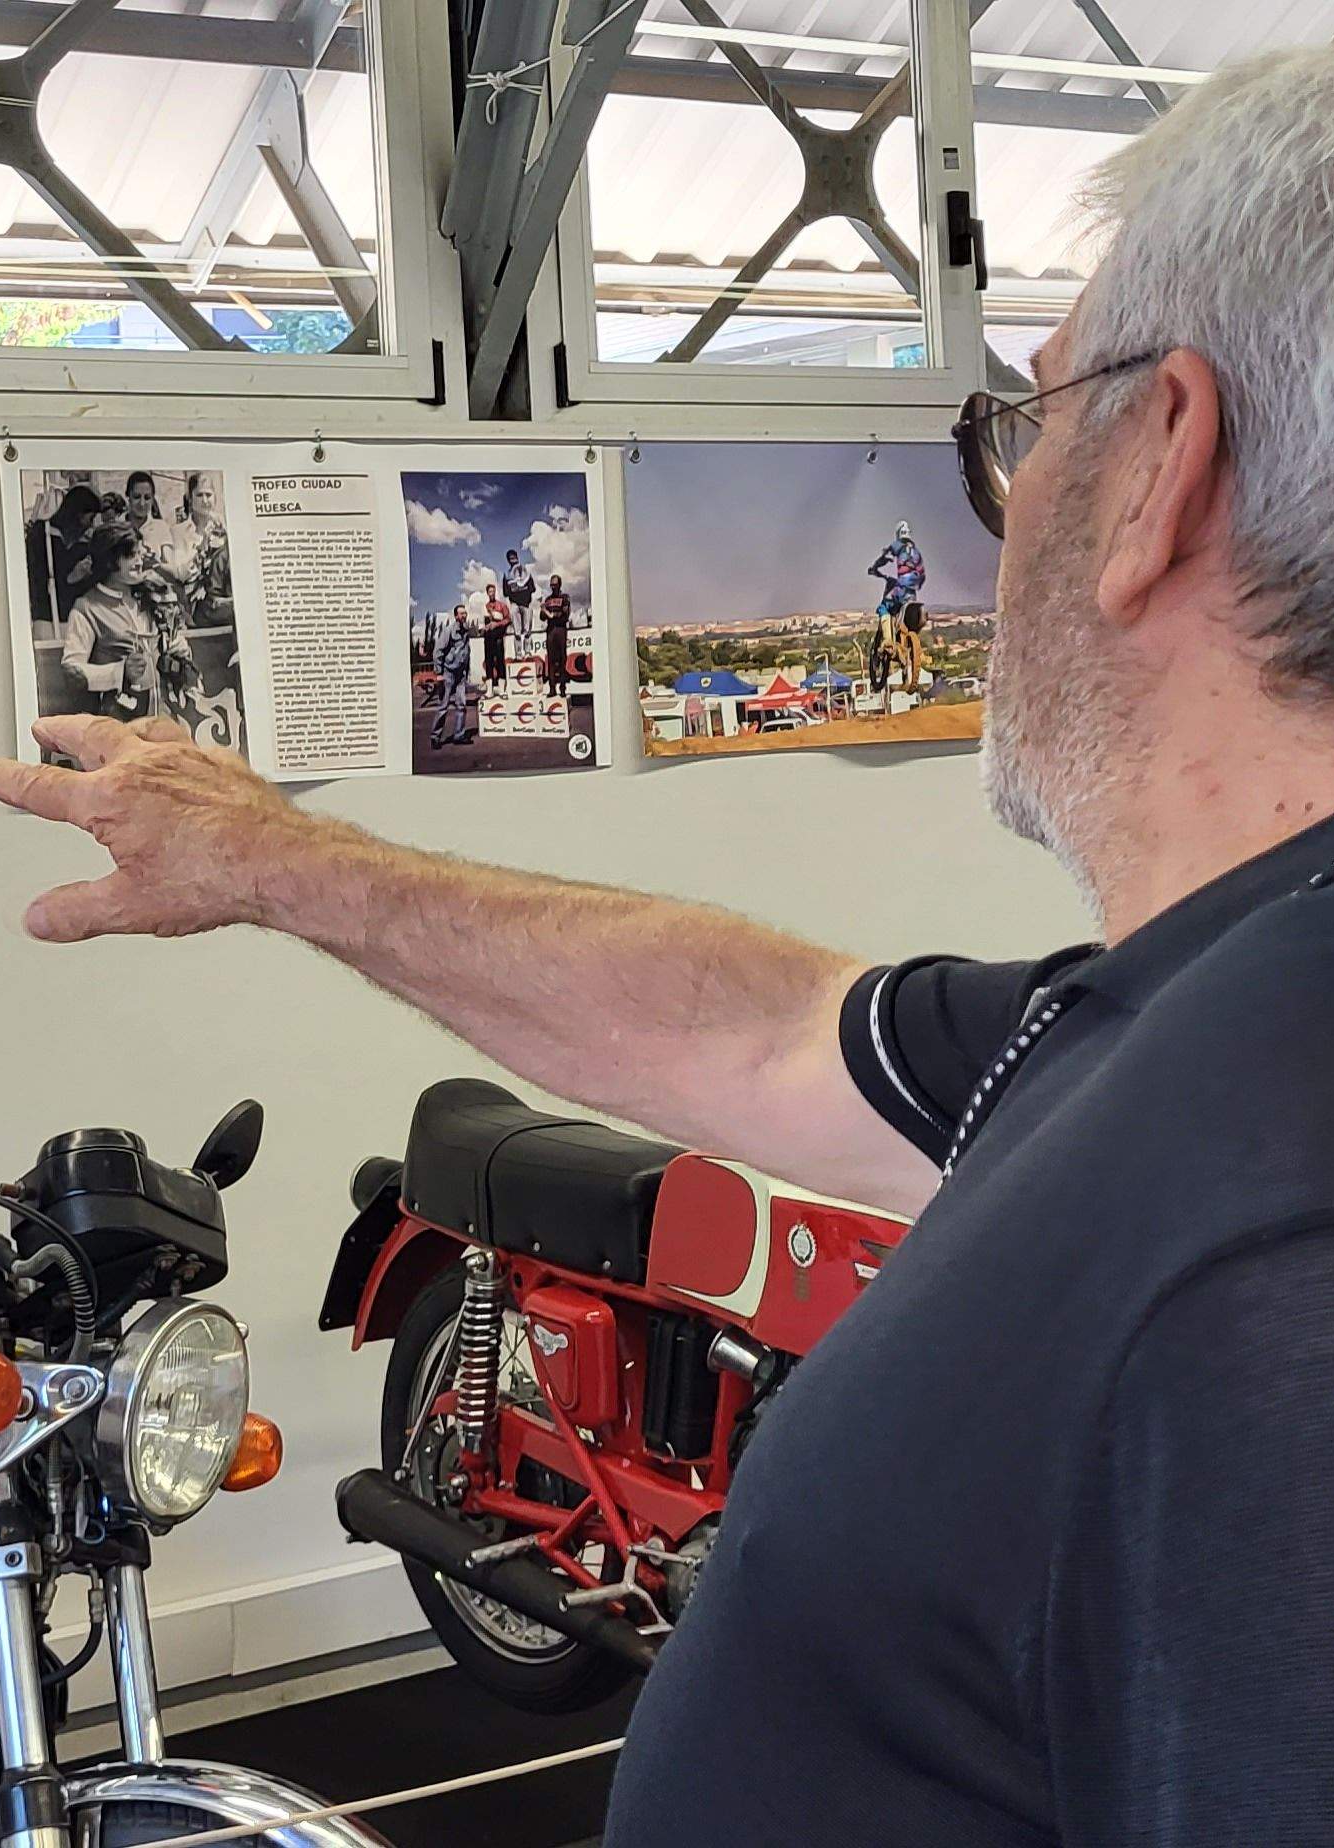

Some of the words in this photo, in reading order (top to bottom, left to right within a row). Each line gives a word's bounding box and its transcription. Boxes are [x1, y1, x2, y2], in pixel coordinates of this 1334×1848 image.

[251, 480, 297, 491] TROFEO
[301, 479, 342, 489] CIUDAD
[254, 493, 269, 502] DE
[255, 503, 302, 513] HUESCA
[479, 701, 485, 713] 2
[539, 700, 544, 714] 3
